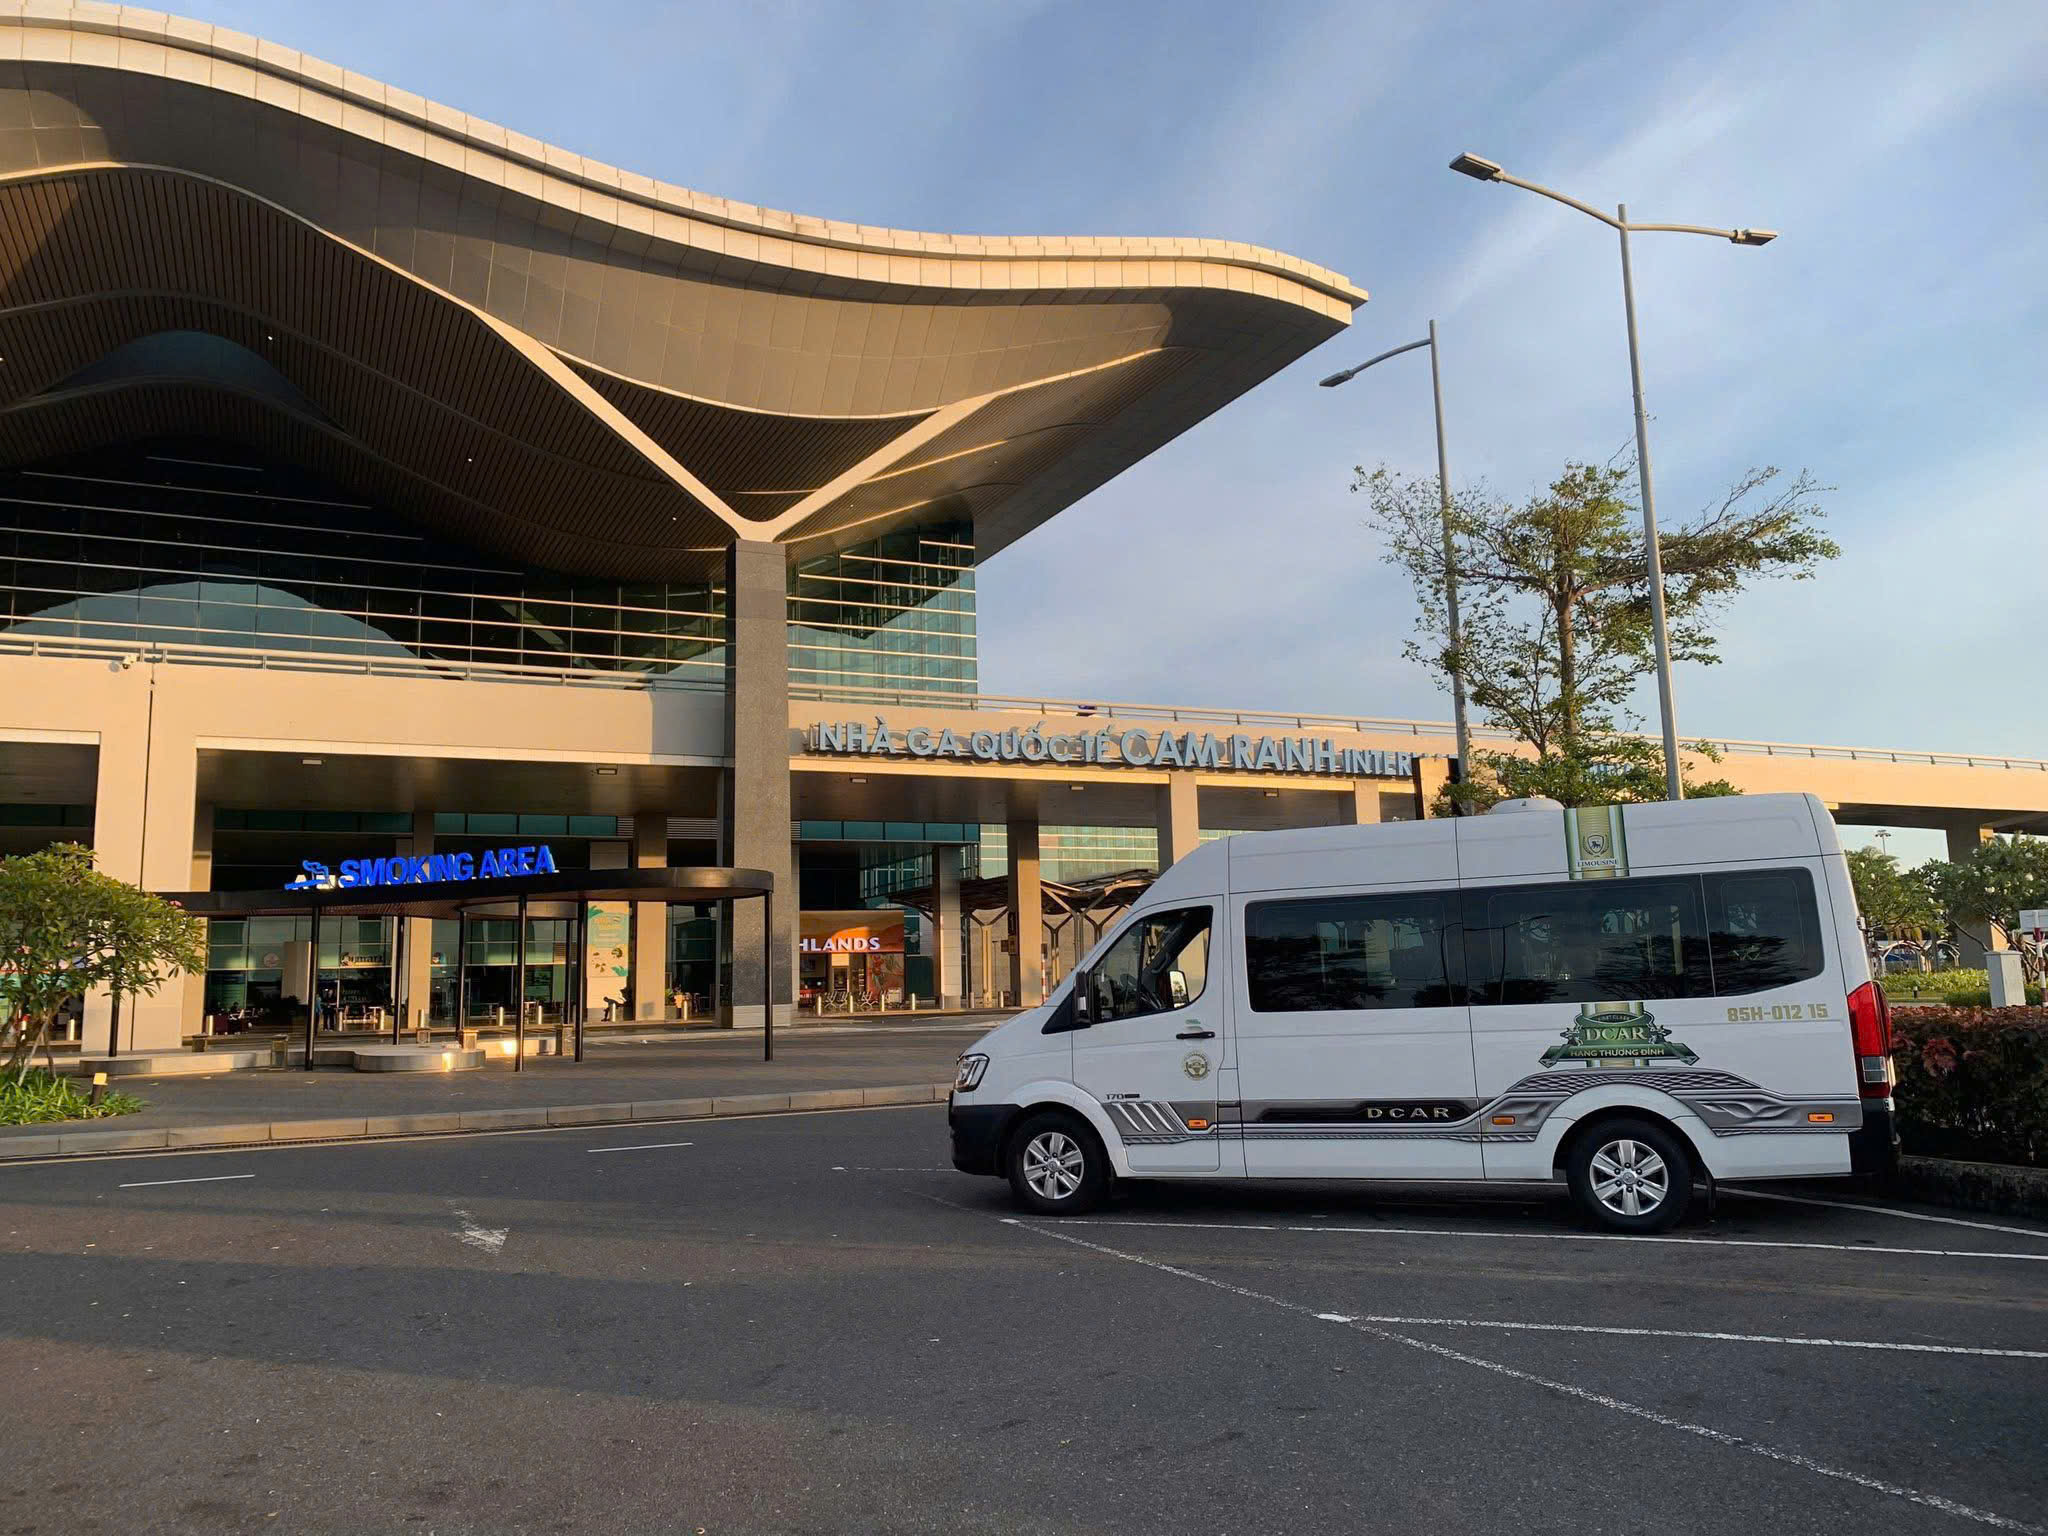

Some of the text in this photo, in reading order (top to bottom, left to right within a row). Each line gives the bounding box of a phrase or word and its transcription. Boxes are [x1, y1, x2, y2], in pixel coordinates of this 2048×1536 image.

[819, 714, 896, 753] NHÀ
[906, 727, 960, 757] GA
[971, 720, 1073, 762] QUỐC
[1120, 728, 1221, 768] CAM
[1231, 733, 1337, 773] RANH
[1343, 748, 1413, 776] INTER
[340, 845, 556, 888] SMOKING AREA
[799, 937, 880, 951] HLANDS
[1586, 1026, 1648, 1041] DCAR
[1367, 1107, 1450, 1119] DCAR
